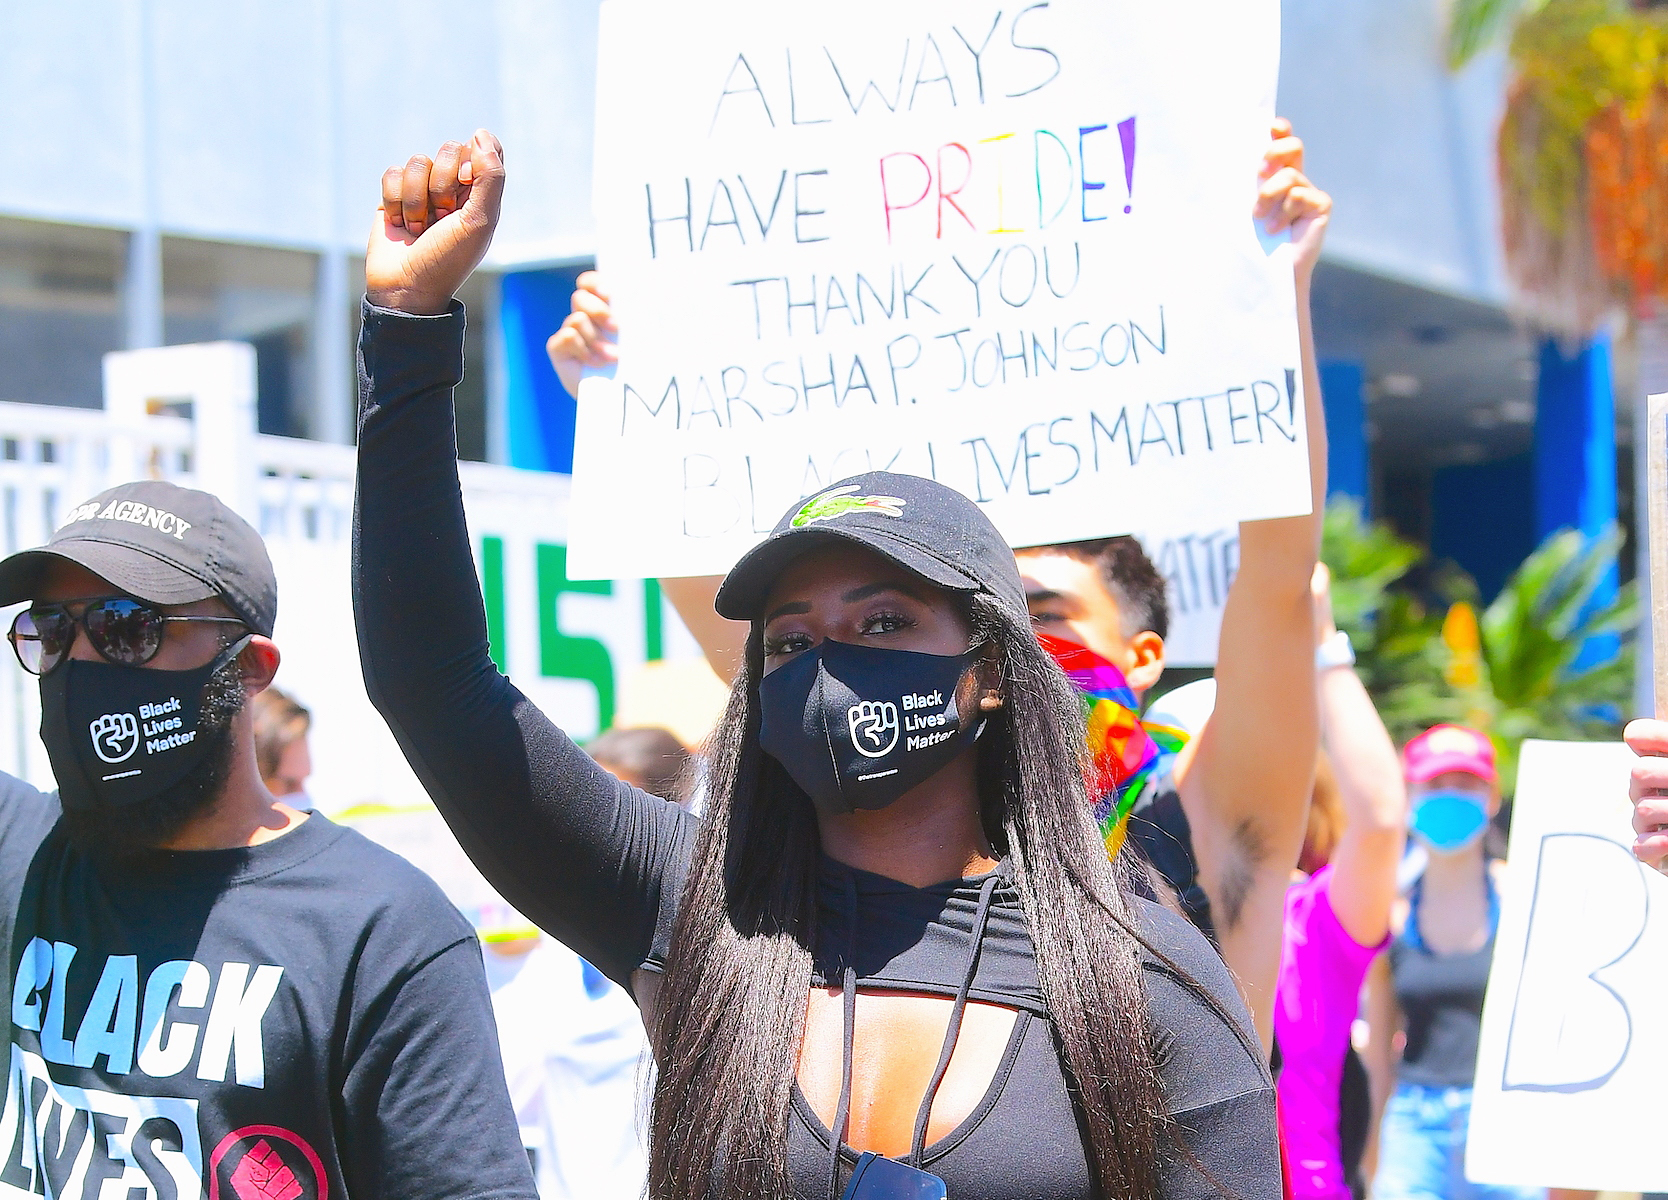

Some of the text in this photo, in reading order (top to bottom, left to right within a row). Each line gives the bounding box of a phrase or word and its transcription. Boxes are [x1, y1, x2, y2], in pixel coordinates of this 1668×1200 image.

[709, 2, 1061, 136] ALWAYS
[645, 115, 1138, 259] HAVE PRIDE!
[729, 242, 1081, 340] THANK YOU
[621, 305, 1166, 436] MARSHA P. JOHNSON
[682, 446, 903, 538] BLA
[1090, 368, 1298, 472] MATTER!
[98, 499, 192, 540] AGENCY
[138, 696, 182, 720] Black
[901, 689, 943, 711] Black
[142, 716, 183, 737] Lives
[145, 730, 197, 755] Matter
[904, 712, 946, 732] Lives
[906, 729, 956, 752] Matter
[11, 934, 284, 1090] BLACK
